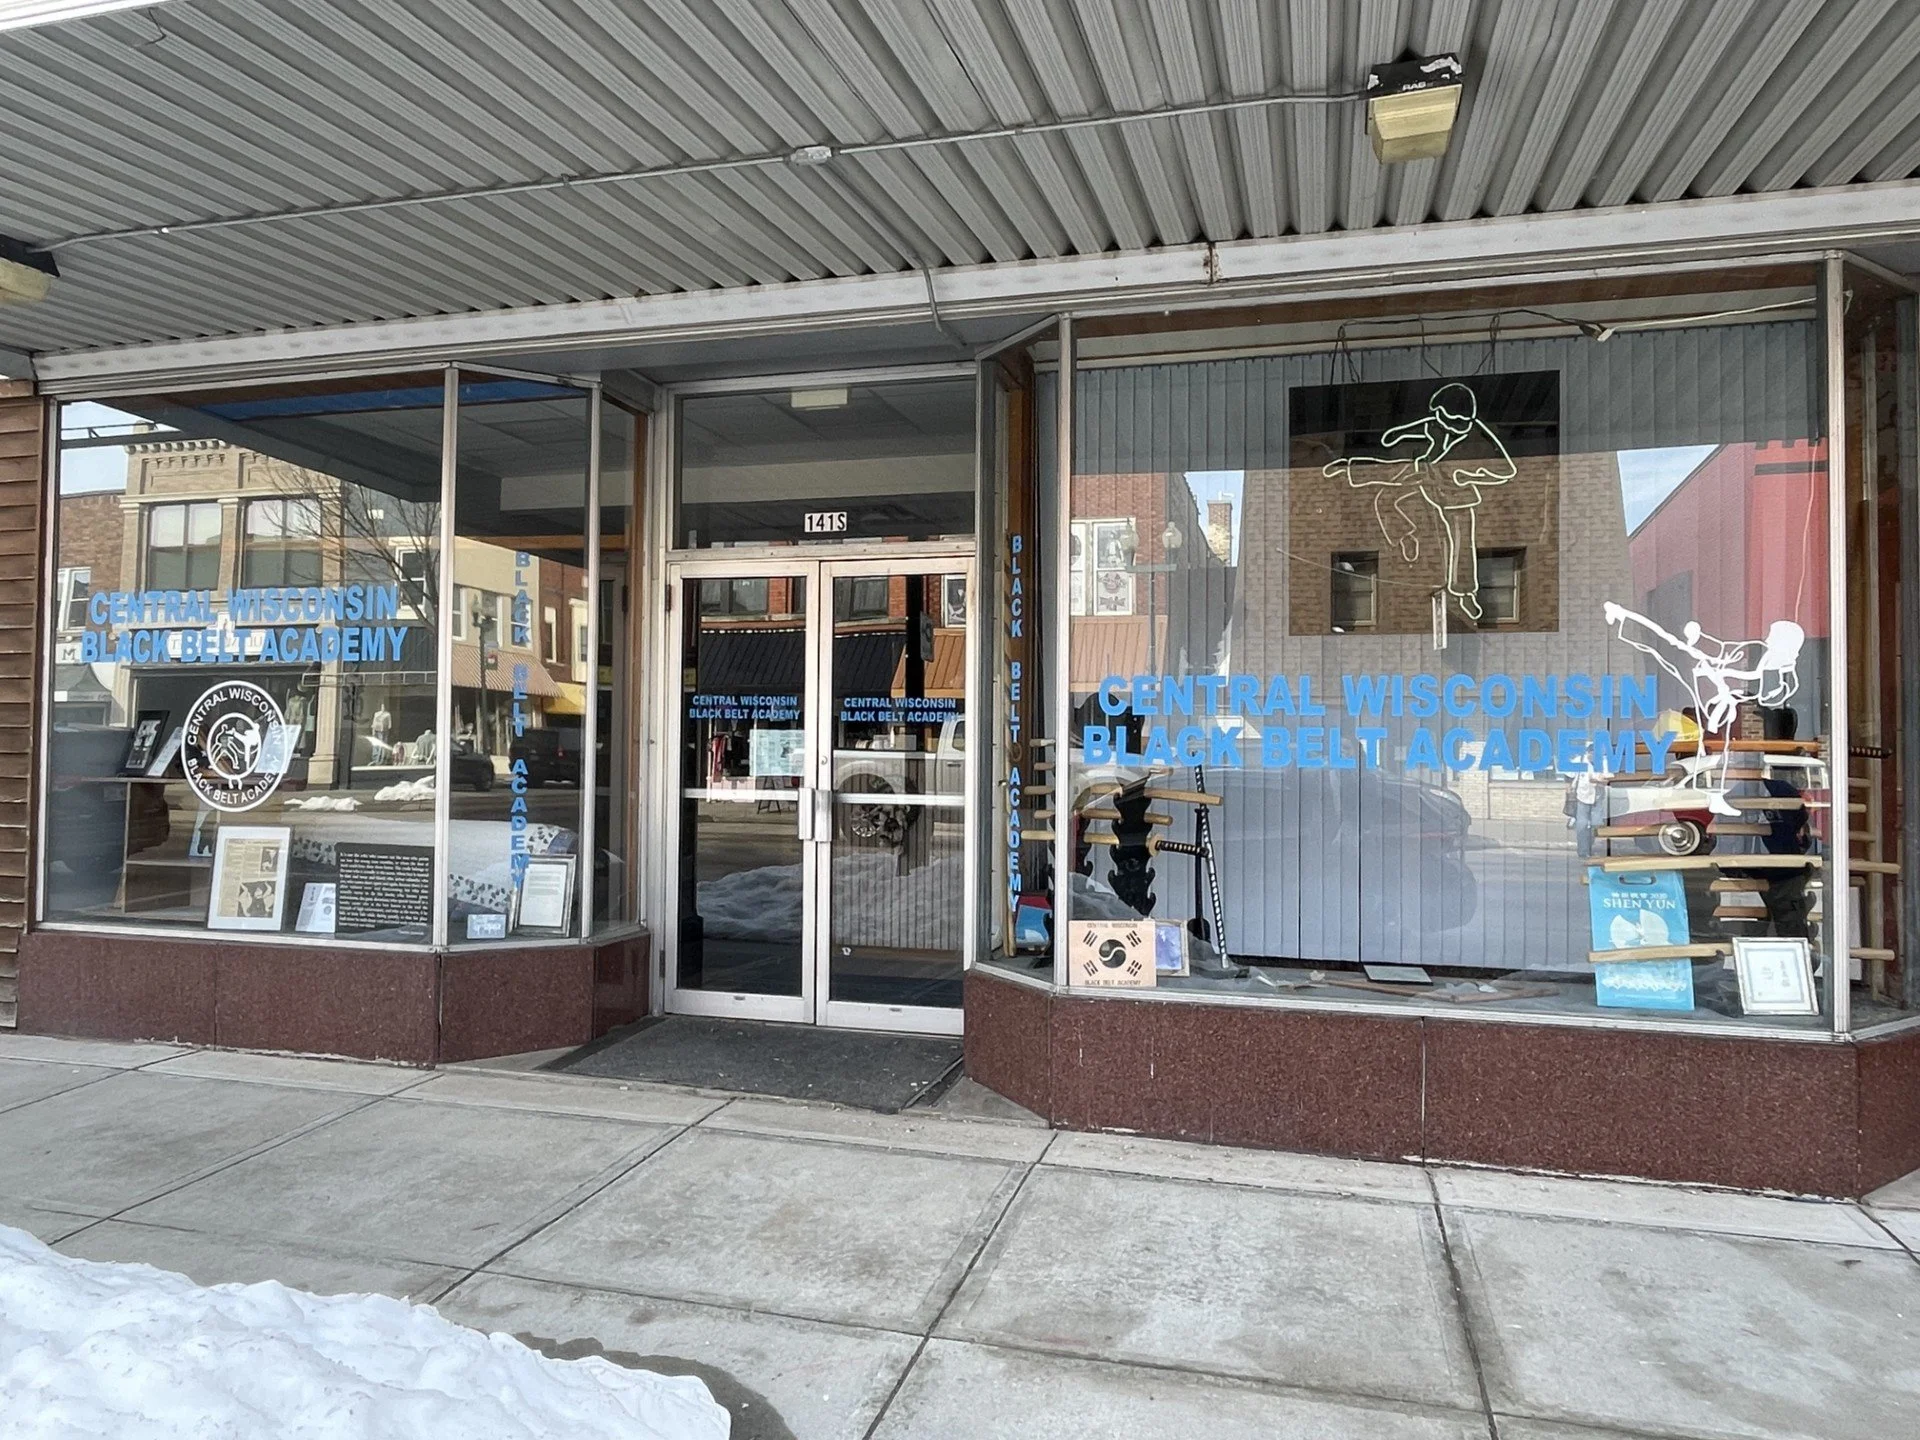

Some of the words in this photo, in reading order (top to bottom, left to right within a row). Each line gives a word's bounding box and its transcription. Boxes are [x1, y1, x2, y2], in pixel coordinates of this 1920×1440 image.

[807, 513, 846, 531] 141S
[90, 590, 218, 626] CENTRAL
[227, 584, 398, 624] WISCONSIN
[513, 551, 531, 645] BLACK
[1011, 535, 1023, 638] BLACK
[81, 629, 171, 664] BLACK
[180, 628, 252, 663] BELT
[259, 626, 408, 662] ACADEMY
[187, 690, 228, 746] CENTRAL
[228, 688, 282, 746] WISCONSIN
[512, 664, 528, 738] BELT
[689, 708, 722, 719] BLACK
[724, 709, 749, 719] BELT
[751, 709, 800, 720] ACADEMY
[692, 695, 738, 706] CENTRAL
[740, 696, 798, 706] WISCONSIN
[840, 711, 875, 722] BLACK
[878, 711, 904, 722] BELT
[907, 712, 960, 723] ACADEMY
[843, 697, 892, 708] CENTRAL
[895, 698, 956, 709] WISCONSIN
[1010, 661, 1022, 743] BELT
[1099, 674, 1325, 717] CENTRAL
[1342, 674, 1657, 719] WISCONSIN
[1083, 725, 1243, 767] BLACK
[1262, 726, 1388, 770] BELT
[1406, 728, 1677, 775] ACADEMY
[187, 758, 213, 795] BLACK
[212, 789, 239, 804] BELT
[511, 758, 529, 889] ACADEMY
[1008, 767, 1022, 912] ACADEMY
[1603, 898, 1641, 908] SHEN
[1645, 900, 1676, 909] YUN
